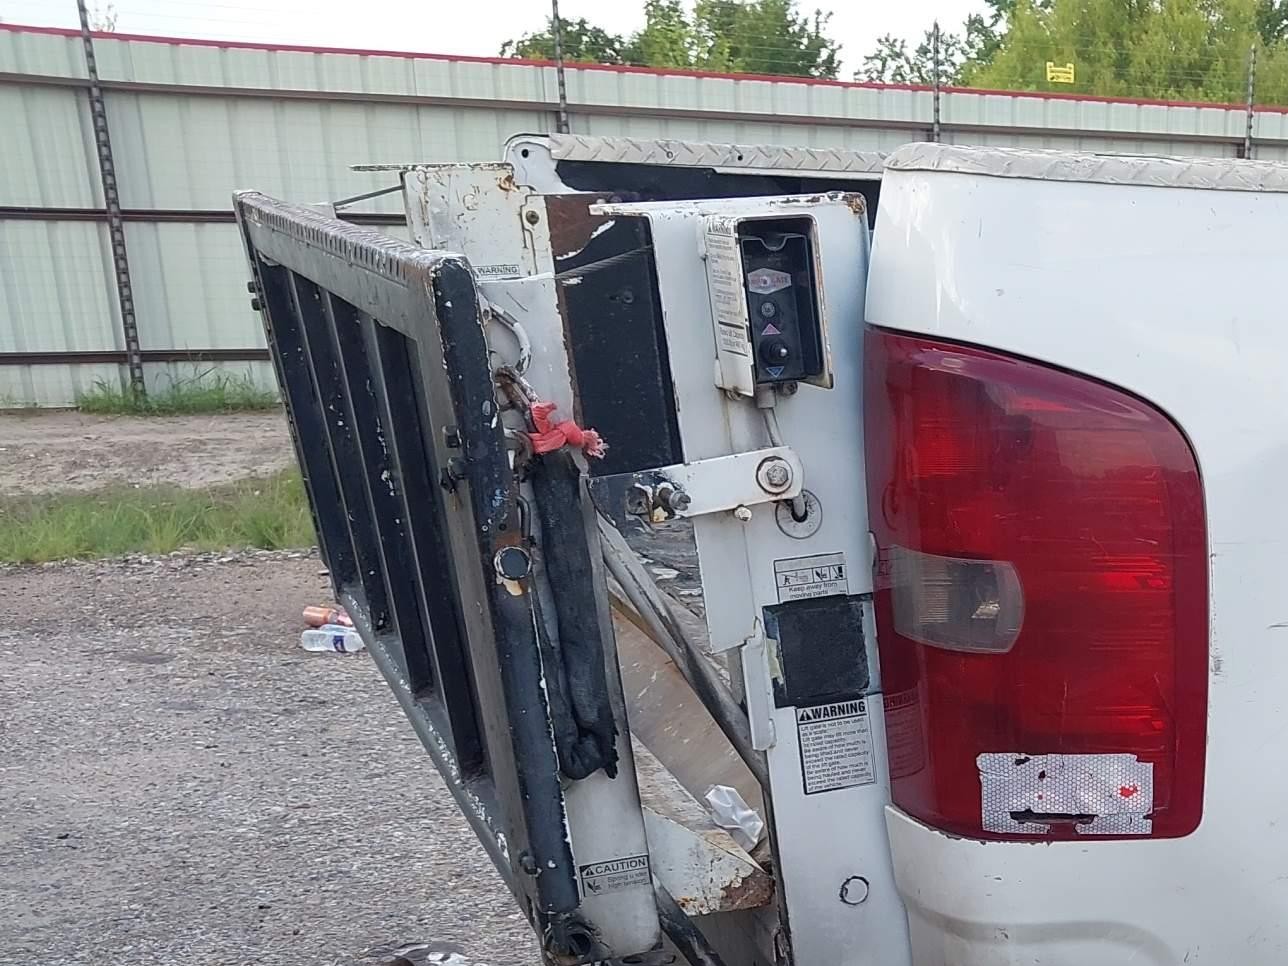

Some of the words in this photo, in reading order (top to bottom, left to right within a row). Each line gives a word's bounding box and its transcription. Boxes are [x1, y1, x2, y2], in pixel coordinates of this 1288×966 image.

[477, 266, 518, 274] WARNING
[811, 701, 866, 719] WARNING
[595, 858, 646, 874] CAUTION
